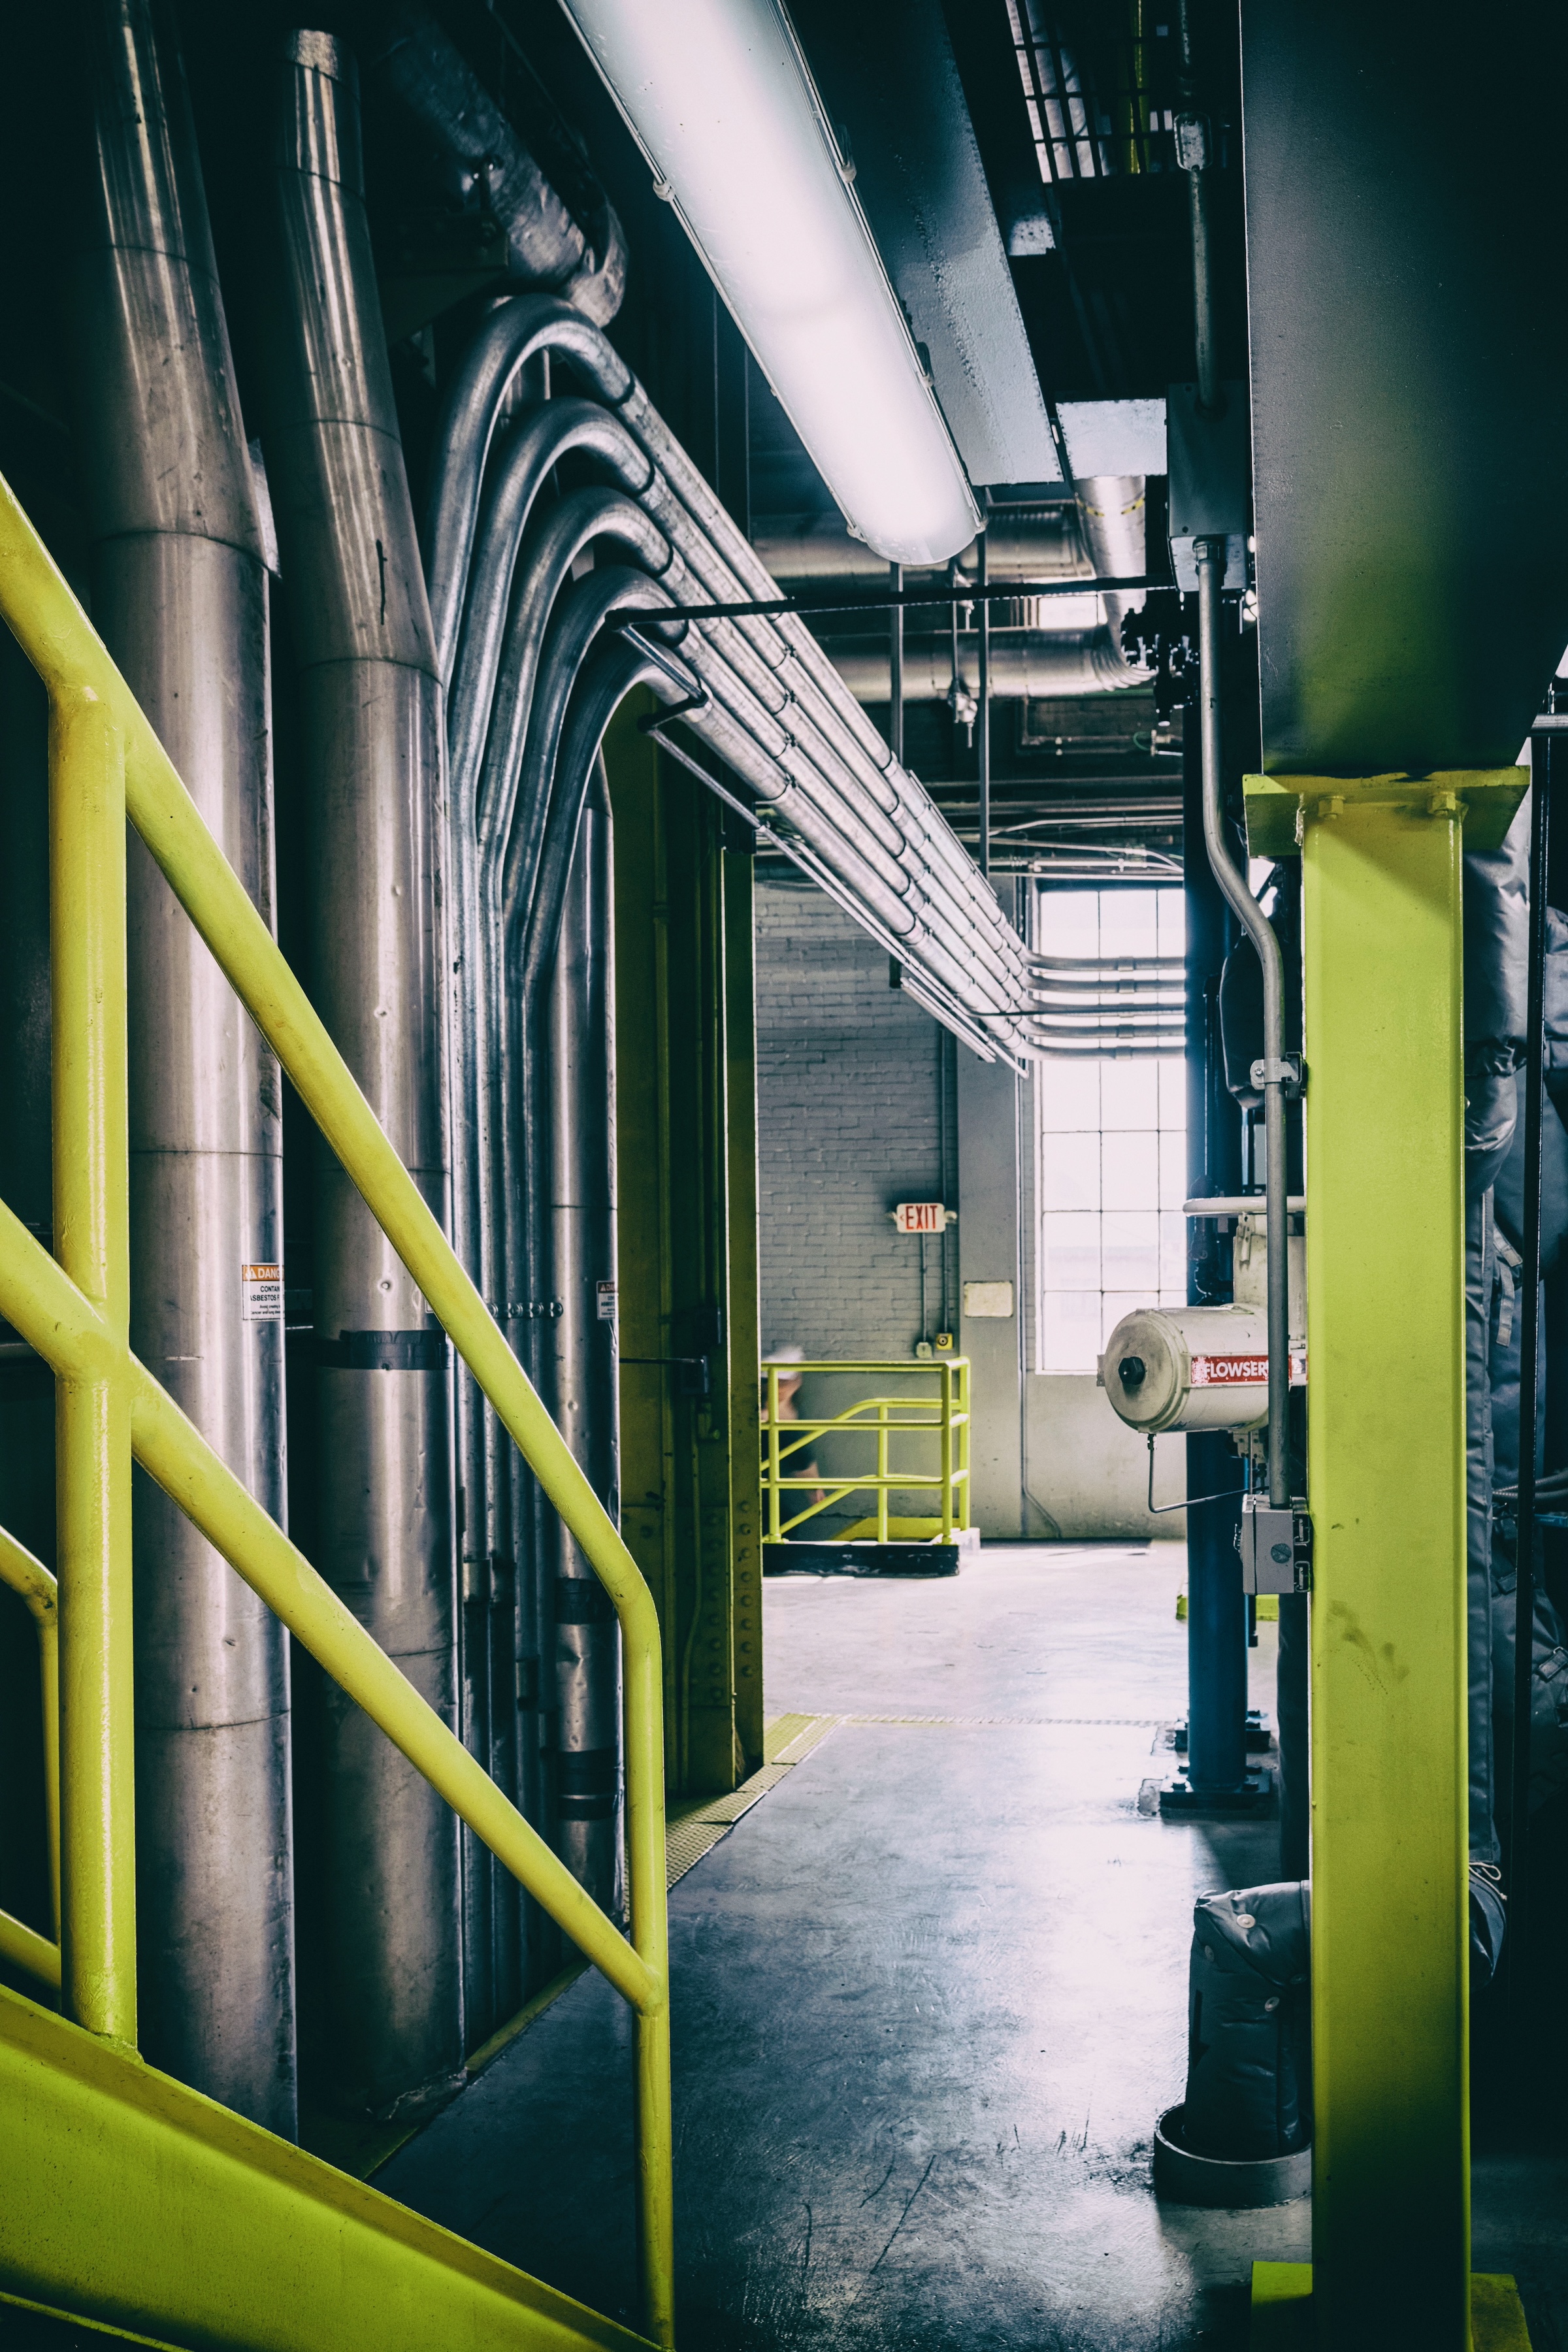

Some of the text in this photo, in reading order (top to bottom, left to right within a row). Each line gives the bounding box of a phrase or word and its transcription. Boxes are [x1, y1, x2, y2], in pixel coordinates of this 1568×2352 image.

[906, 1205, 938, 1230] EXIT
[257, 1267, 280, 1279] DANG
[1203, 1361, 1268, 1378] FLOWSER
